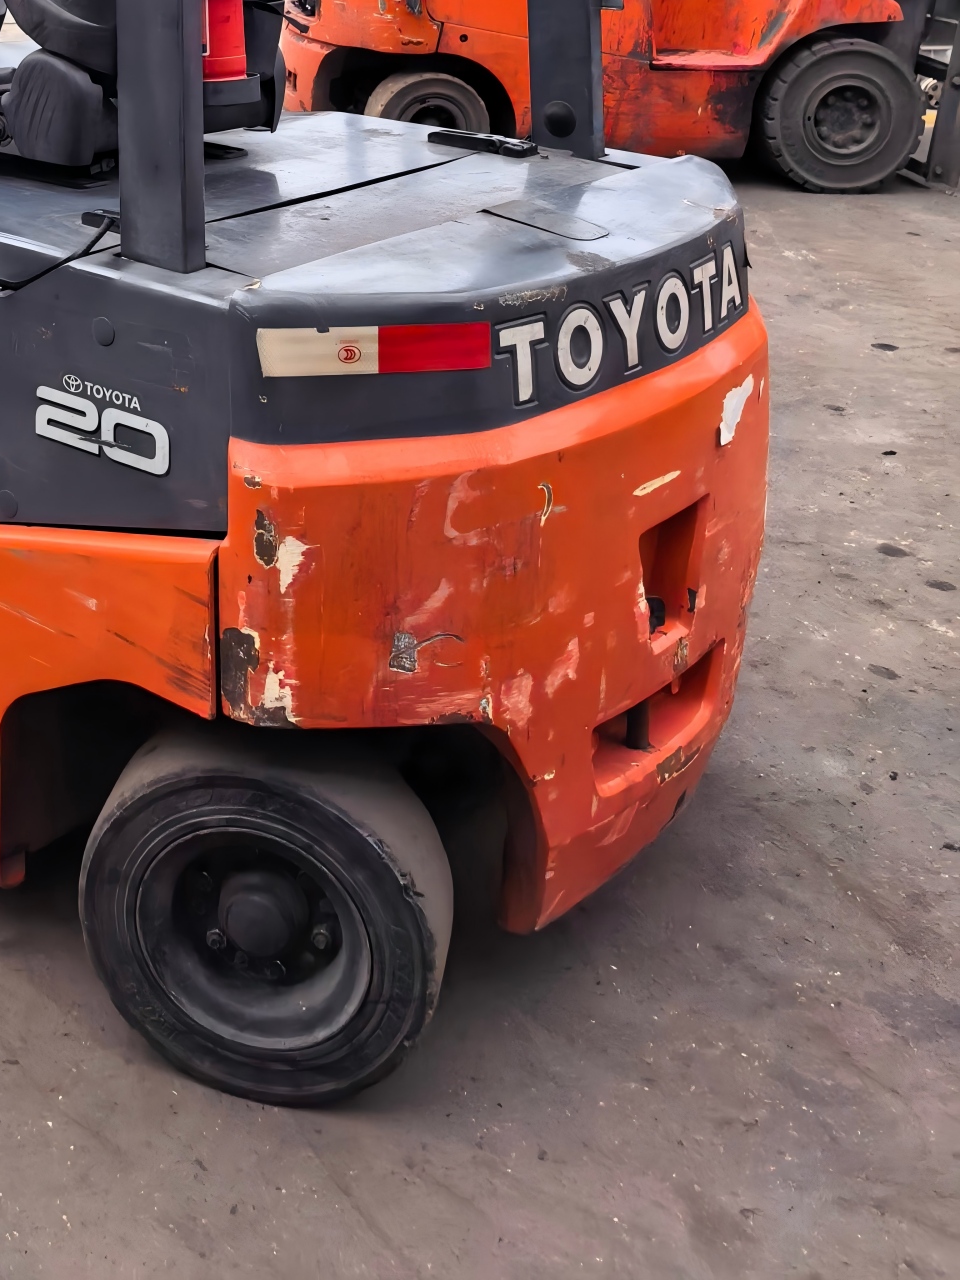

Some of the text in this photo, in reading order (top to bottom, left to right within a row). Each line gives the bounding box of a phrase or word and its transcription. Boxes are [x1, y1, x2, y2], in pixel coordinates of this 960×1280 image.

[498, 244, 742, 403] TOYOTA
[35, 385, 170, 476] 20
[84, 381, 142, 412] TOYOTA
